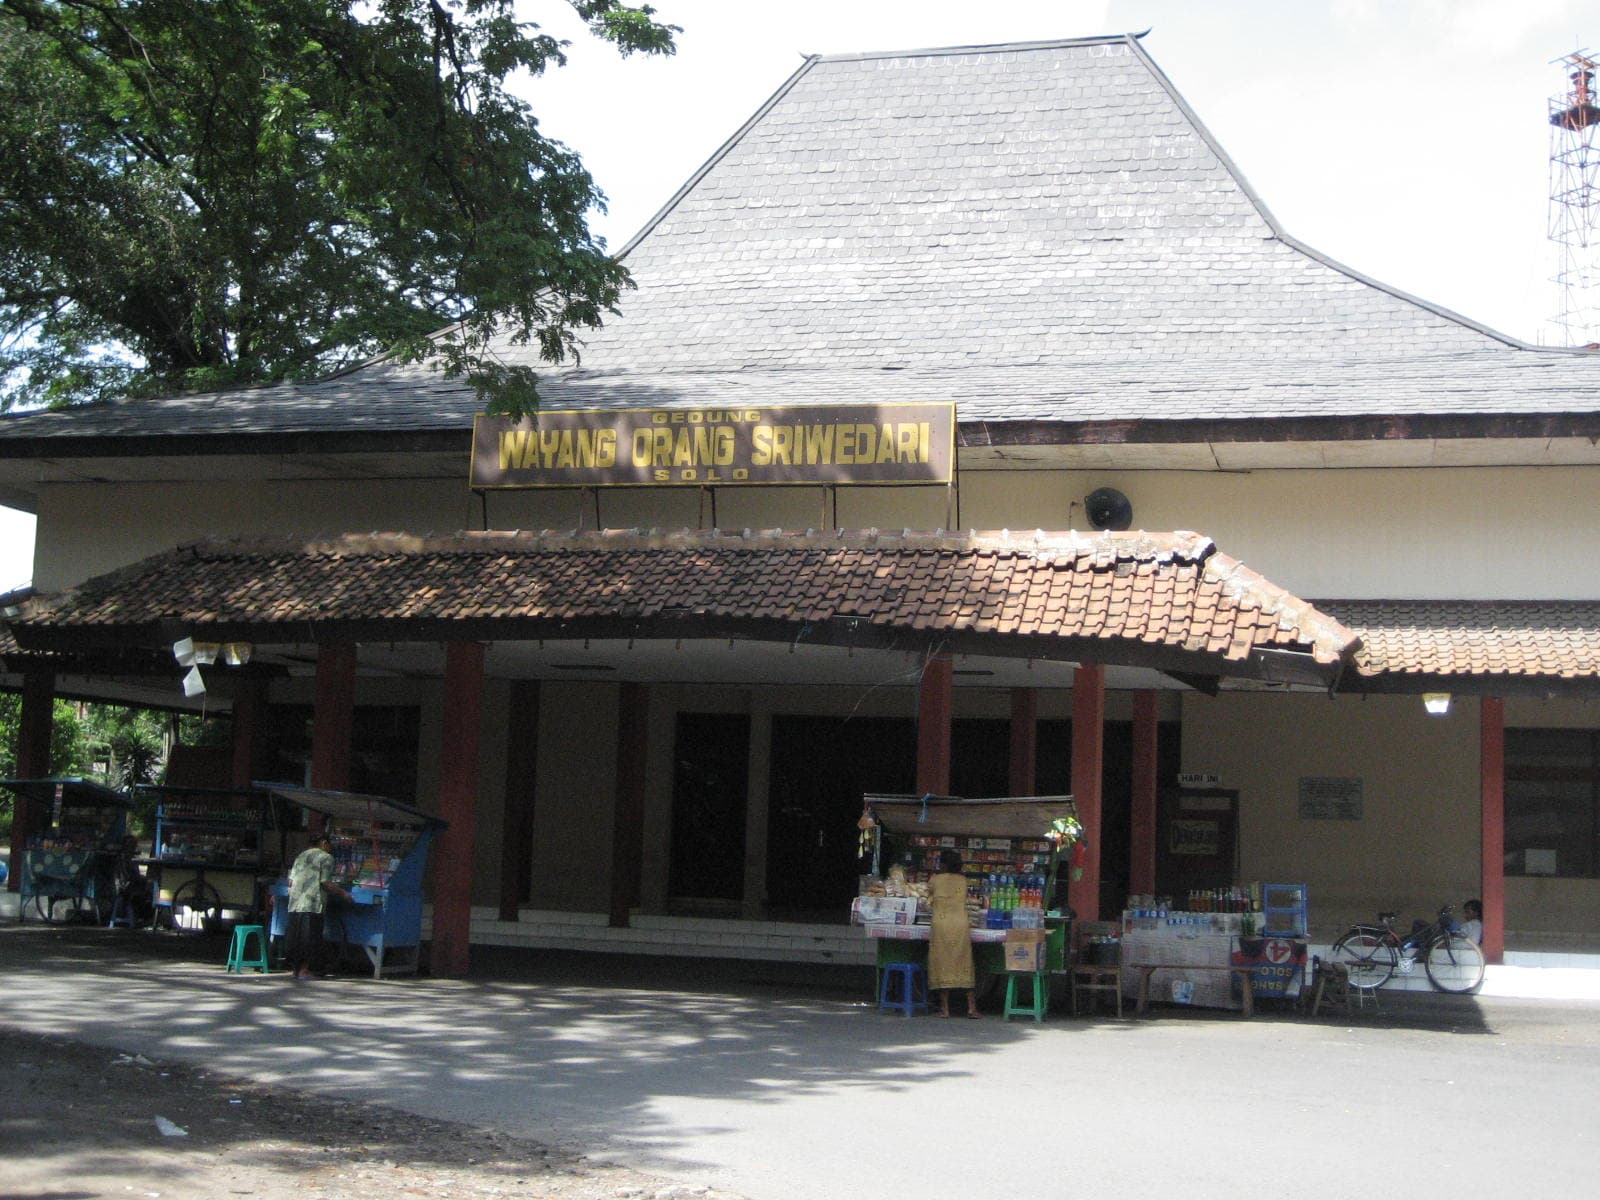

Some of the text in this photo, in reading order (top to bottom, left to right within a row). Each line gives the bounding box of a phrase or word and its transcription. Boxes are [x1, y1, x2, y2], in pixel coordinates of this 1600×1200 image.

[652, 410, 762, 424] GEDUNG
[499, 421, 931, 470] WAYANG ORANG SRIWEDARI
[654, 468, 750, 482] SOLO
[1181, 774, 1219, 783] HARI INI
[1260, 966, 1293, 977] SOLO
